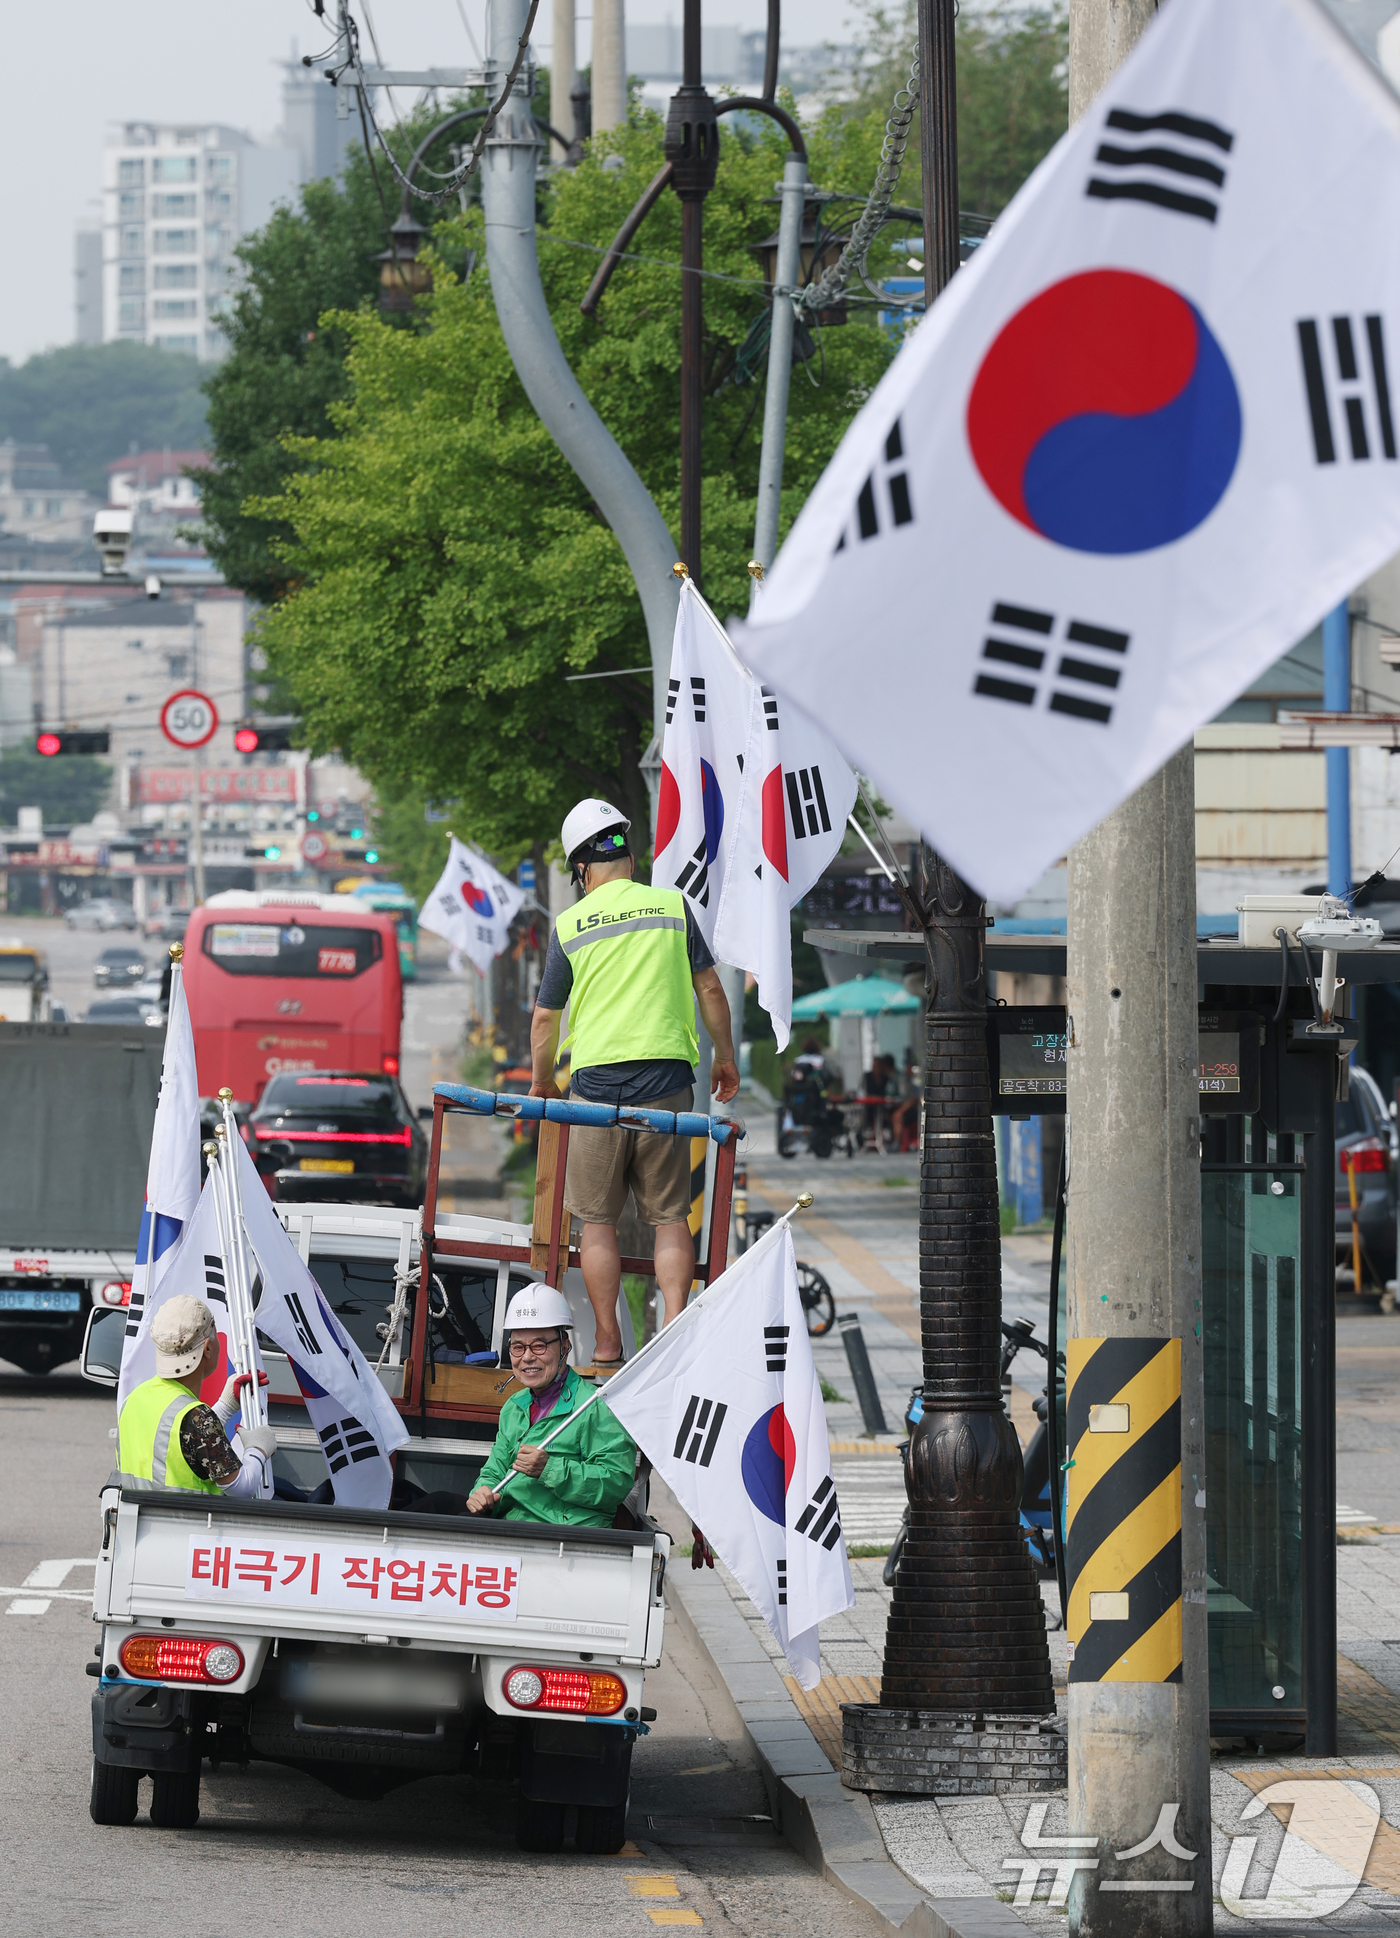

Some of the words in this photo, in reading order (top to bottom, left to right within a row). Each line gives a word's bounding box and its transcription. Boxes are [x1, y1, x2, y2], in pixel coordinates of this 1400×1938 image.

[173, 707, 205, 731] 50
[576, 910, 603, 932] LS
[602, 907, 665, 925] ELECTRIC
[190, 1546, 320, 1596] 태극기
[340, 1556, 518, 1609] 작업차량
[543, 1621, 588, 1635] 최대적재량
